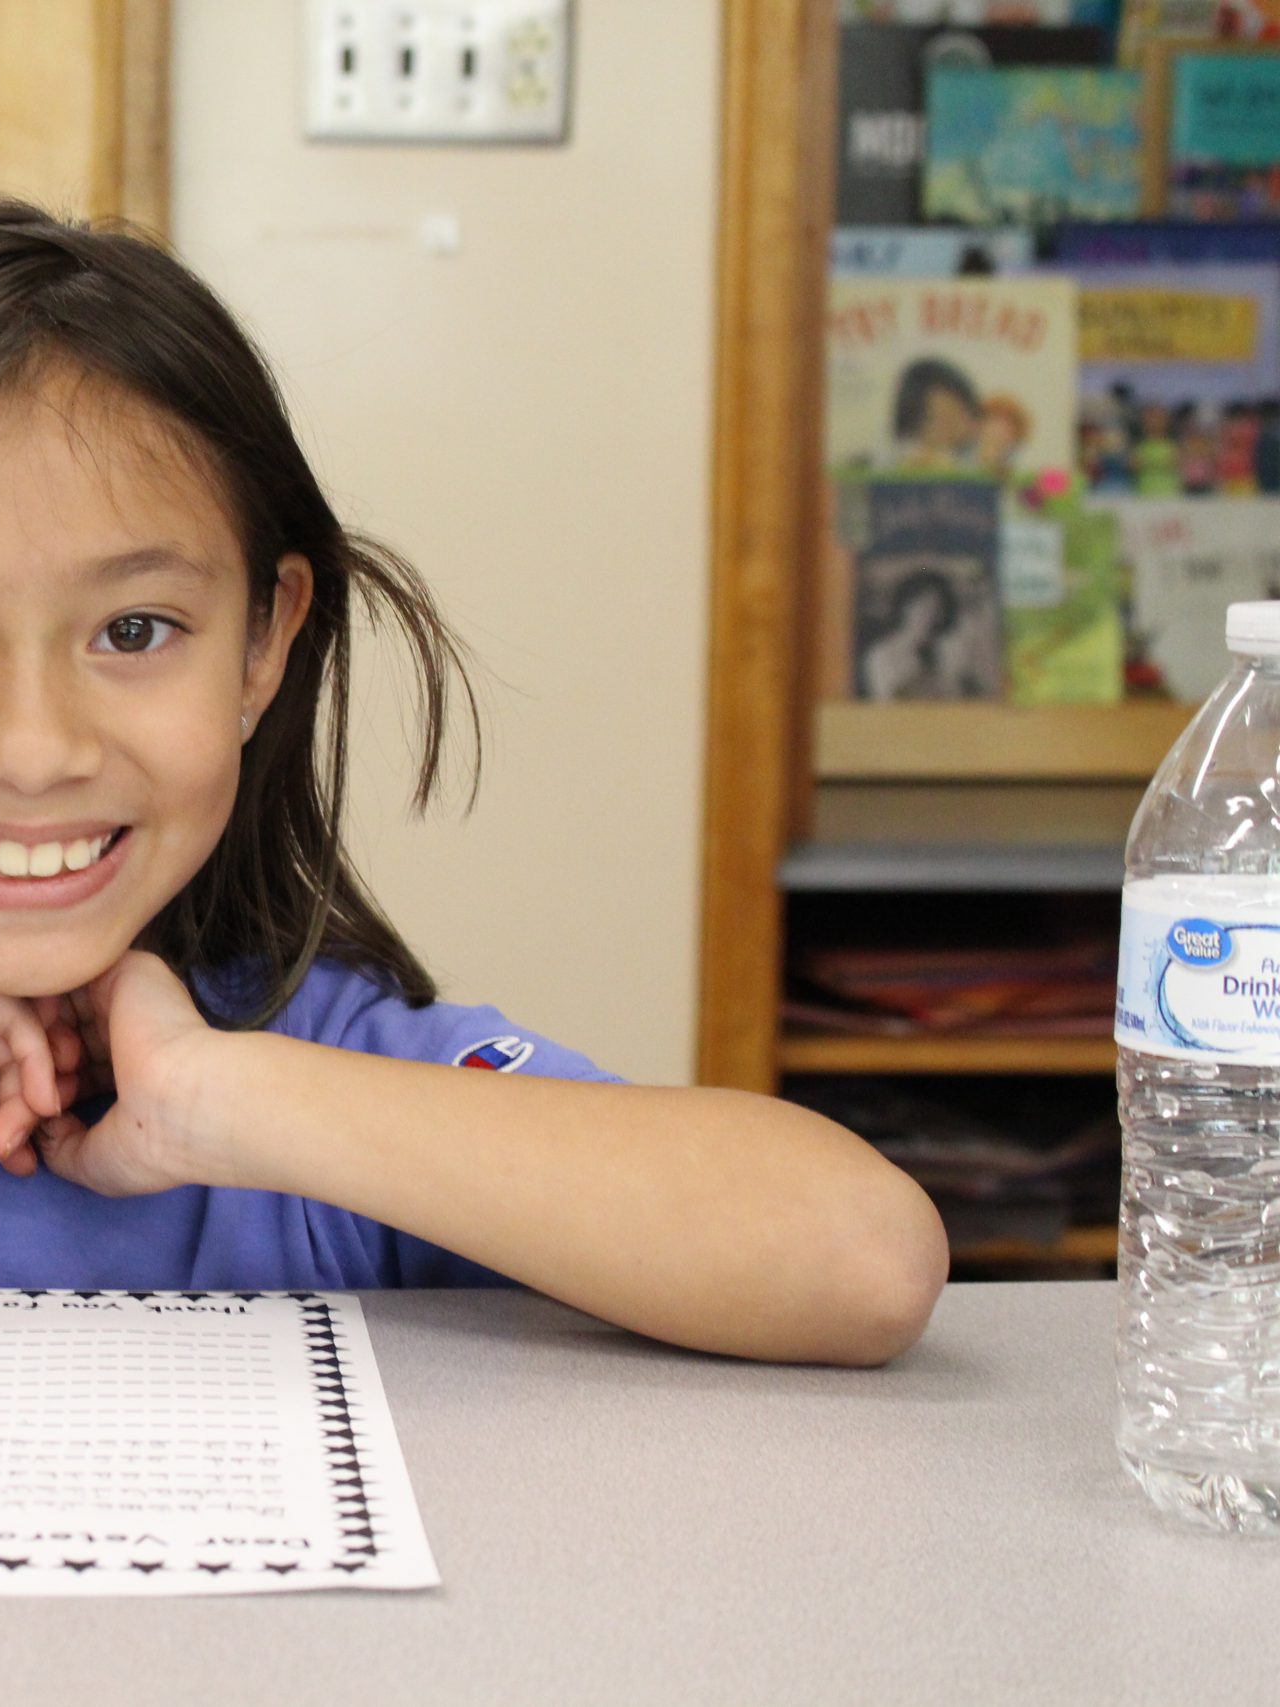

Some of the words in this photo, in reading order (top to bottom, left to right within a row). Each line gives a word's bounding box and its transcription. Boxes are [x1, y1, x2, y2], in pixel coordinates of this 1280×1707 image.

[920, 295, 1048, 354] BREAD
[1174, 926, 1220, 948] Great
[1184, 943, 1221, 959] Value
[61, 1302, 123, 1312] you
[143, 1304, 253, 1316] Thank
[195, 1537, 311, 1551] Dear
